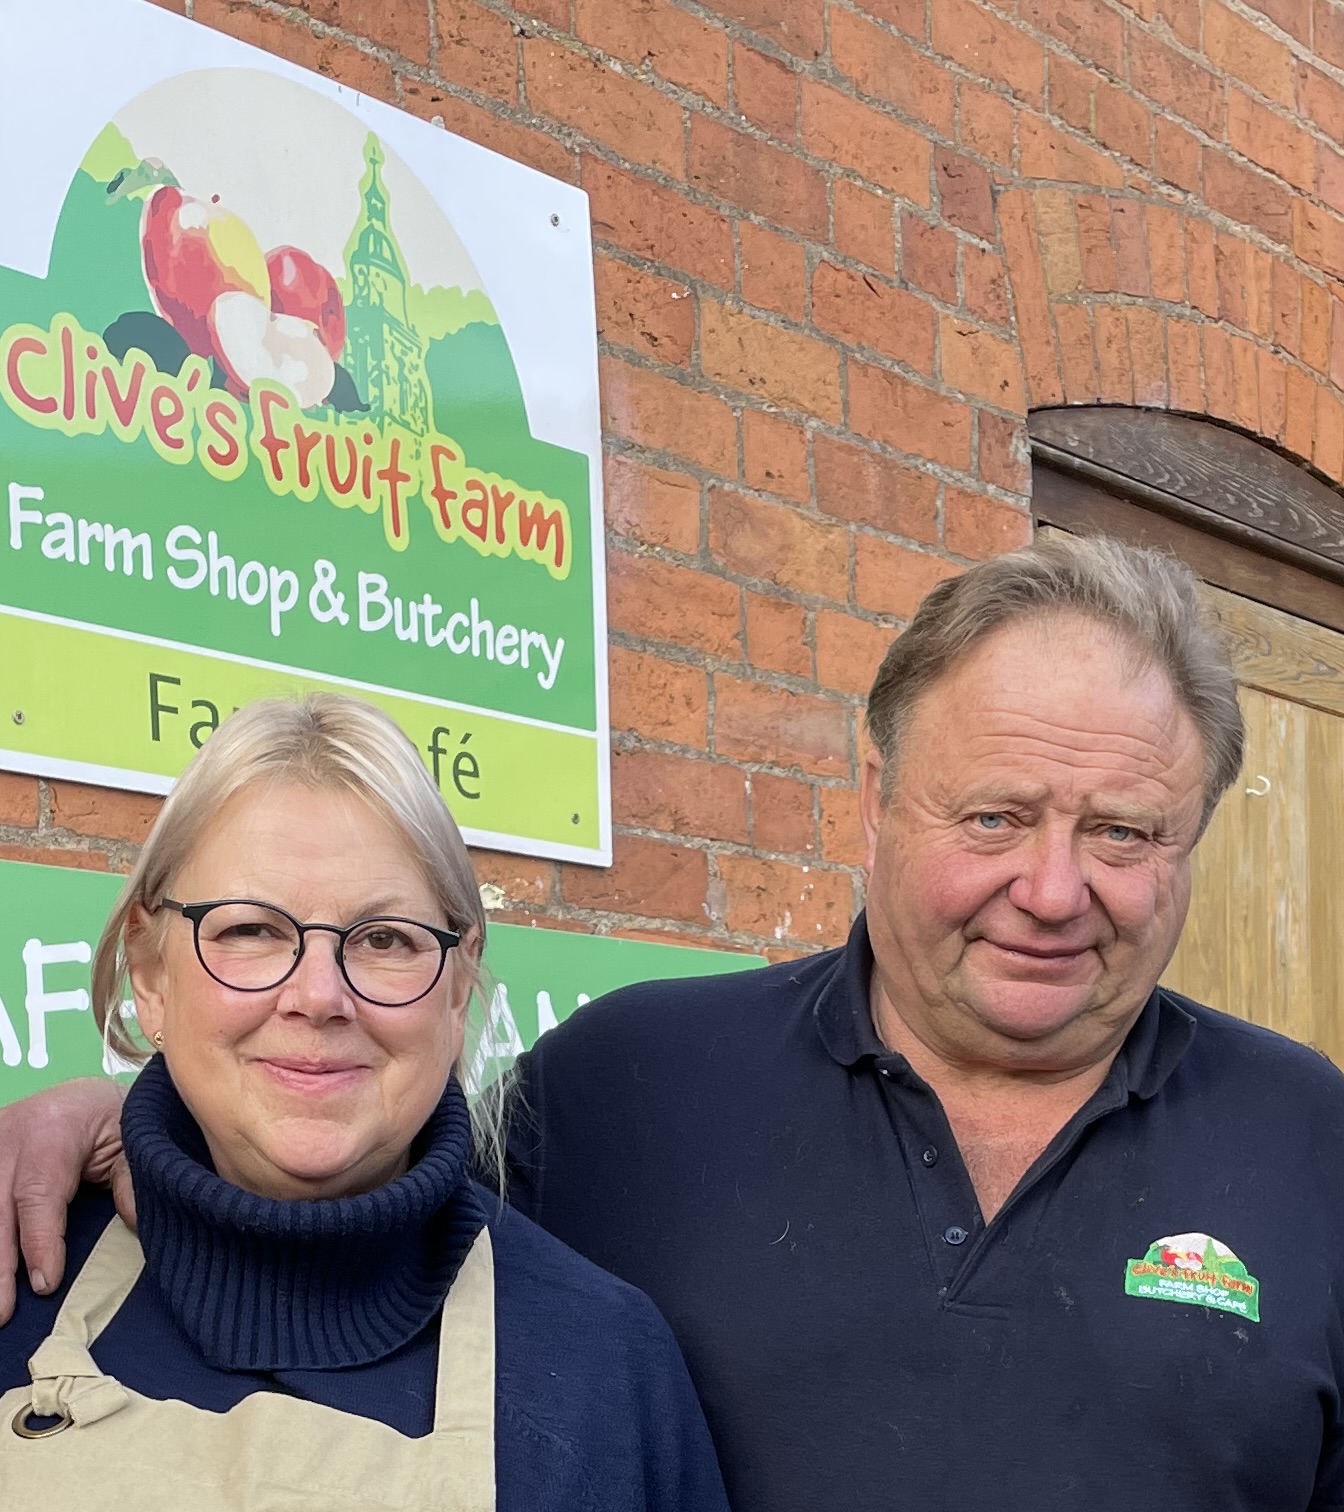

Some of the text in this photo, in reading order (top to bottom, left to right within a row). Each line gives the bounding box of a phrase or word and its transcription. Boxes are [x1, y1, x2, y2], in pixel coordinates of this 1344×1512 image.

[6, 336, 567, 569] Clive's fruit farm
[8, 482, 566, 689] Farm Shop & Butchery
[148, 671, 241, 751] Fa
[1138, 1285, 1202, 1301] BUTCHERY
[1158, 1279, 1230, 1297] FARM SHOP
